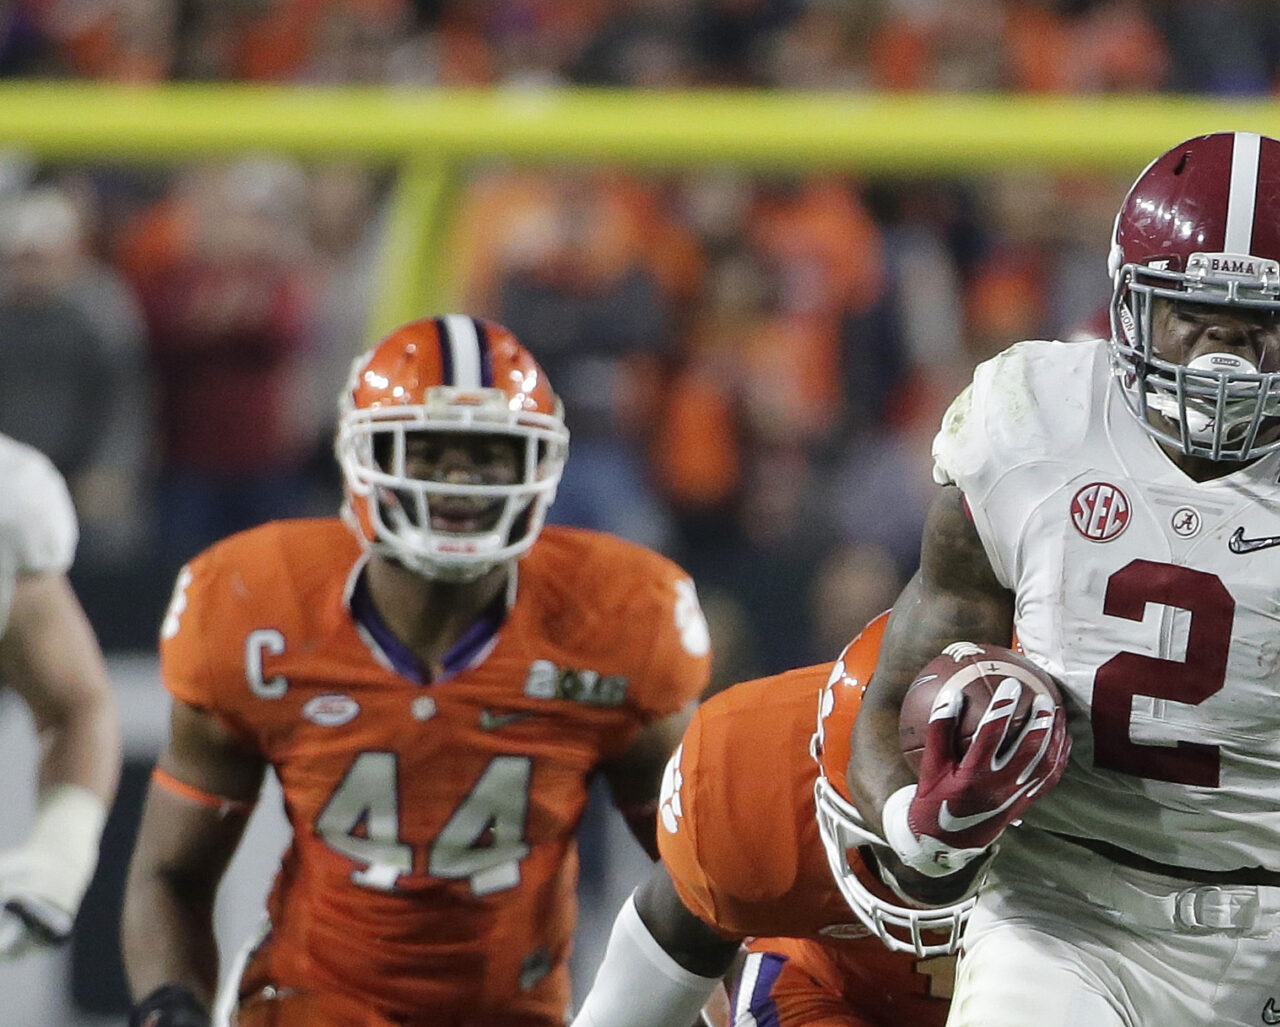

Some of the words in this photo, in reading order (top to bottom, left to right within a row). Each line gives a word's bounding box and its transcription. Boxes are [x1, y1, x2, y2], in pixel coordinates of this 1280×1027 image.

[1211, 259, 1256, 275] BAMA
[1073, 485, 1130, 539] SEC
[244, 628, 288, 699] C
[1090, 558, 1236, 789] 2
[313, 751, 534, 896] 44
